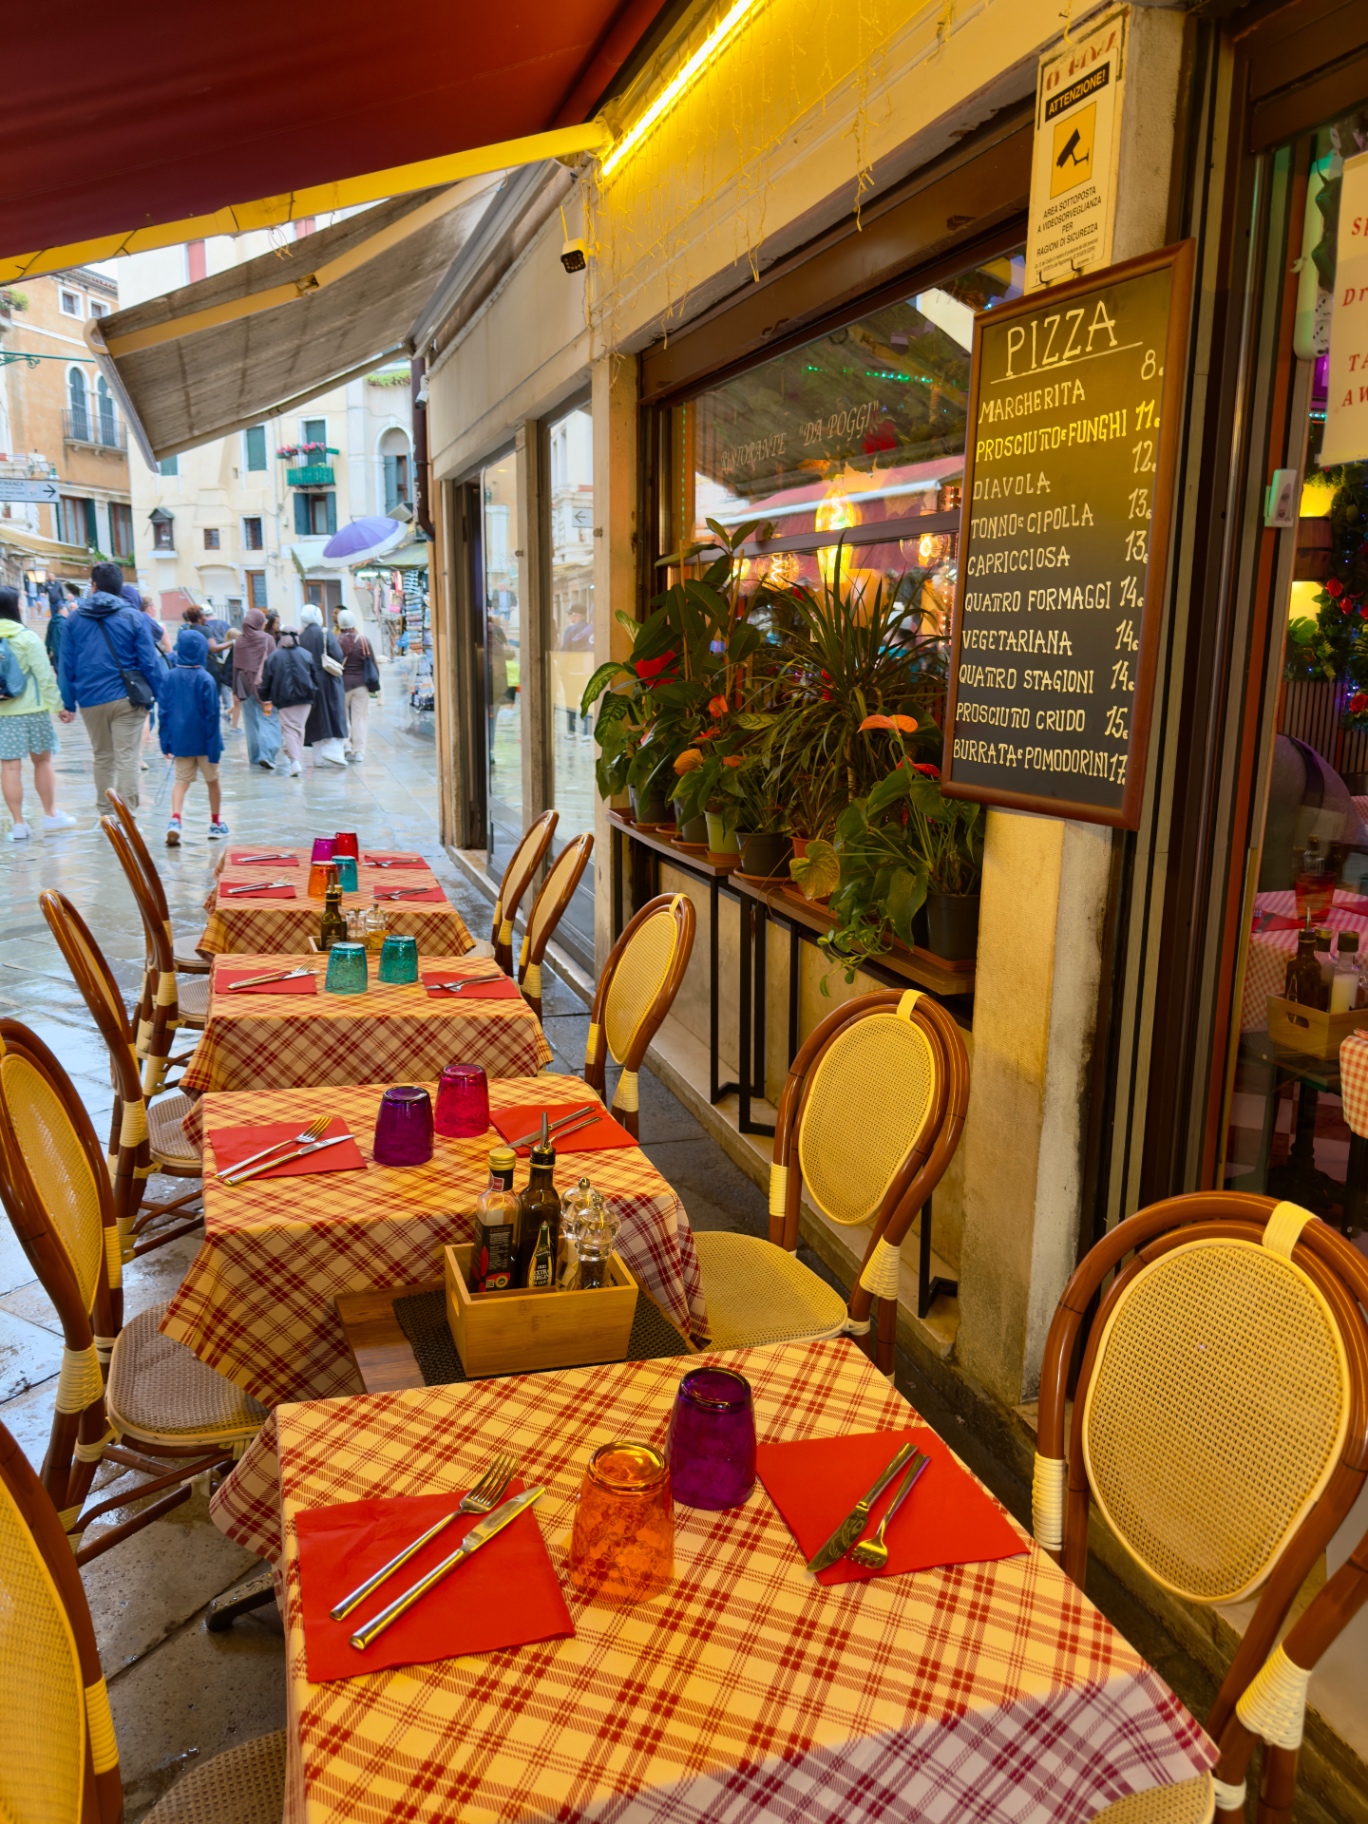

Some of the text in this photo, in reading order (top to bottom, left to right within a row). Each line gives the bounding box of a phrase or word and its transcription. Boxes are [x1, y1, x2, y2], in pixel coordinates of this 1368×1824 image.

[1048, 68, 1106, 116] ATTENZIONE!
[1037, 195, 1102, 234] A VIDEOSORVEGLIANZA
[1043, 185, 1097, 220] AREA SOTTOPOSTA
[1036, 239, 1060, 257] RAGIONI
[1059, 237, 1066, 247] DI
[1066, 221, 1099, 244] SICUREZZA
[1061, 221, 1074, 235] PER
[1005, 300, 1118, 376] PIZZA
[978, 378, 1085, 424] MARGHERITA
[720, 432, 788, 476] RISTORANTE
[827, 400, 880, 442] POGGI"
[975, 426, 1061, 463] PROSCIUTTO
[1067, 409, 1127, 447] FUNGHI
[972, 471, 1051, 501] DIAVOLA
[970, 513, 1017, 540] TONNO
[1026, 502, 1095, 534] CIPOLLA
[967, 545, 1071, 577] CAPRICCIOSA
[964, 590, 1021, 613] QUATTRO
[1027, 581, 1112, 612] FORMAGGI
[962, 629, 1073, 656] VEGETARIANA
[958, 663, 1018, 690] QUATTRO
[1023, 669, 1095, 695] STAGIONI
[955, 702, 1031, 729] PROSCIUTTO
[1035, 709, 1086, 732] CRUDO
[953, 739, 1018, 768] BURRATA
[1023, 746, 1109, 779] POMODORINI
